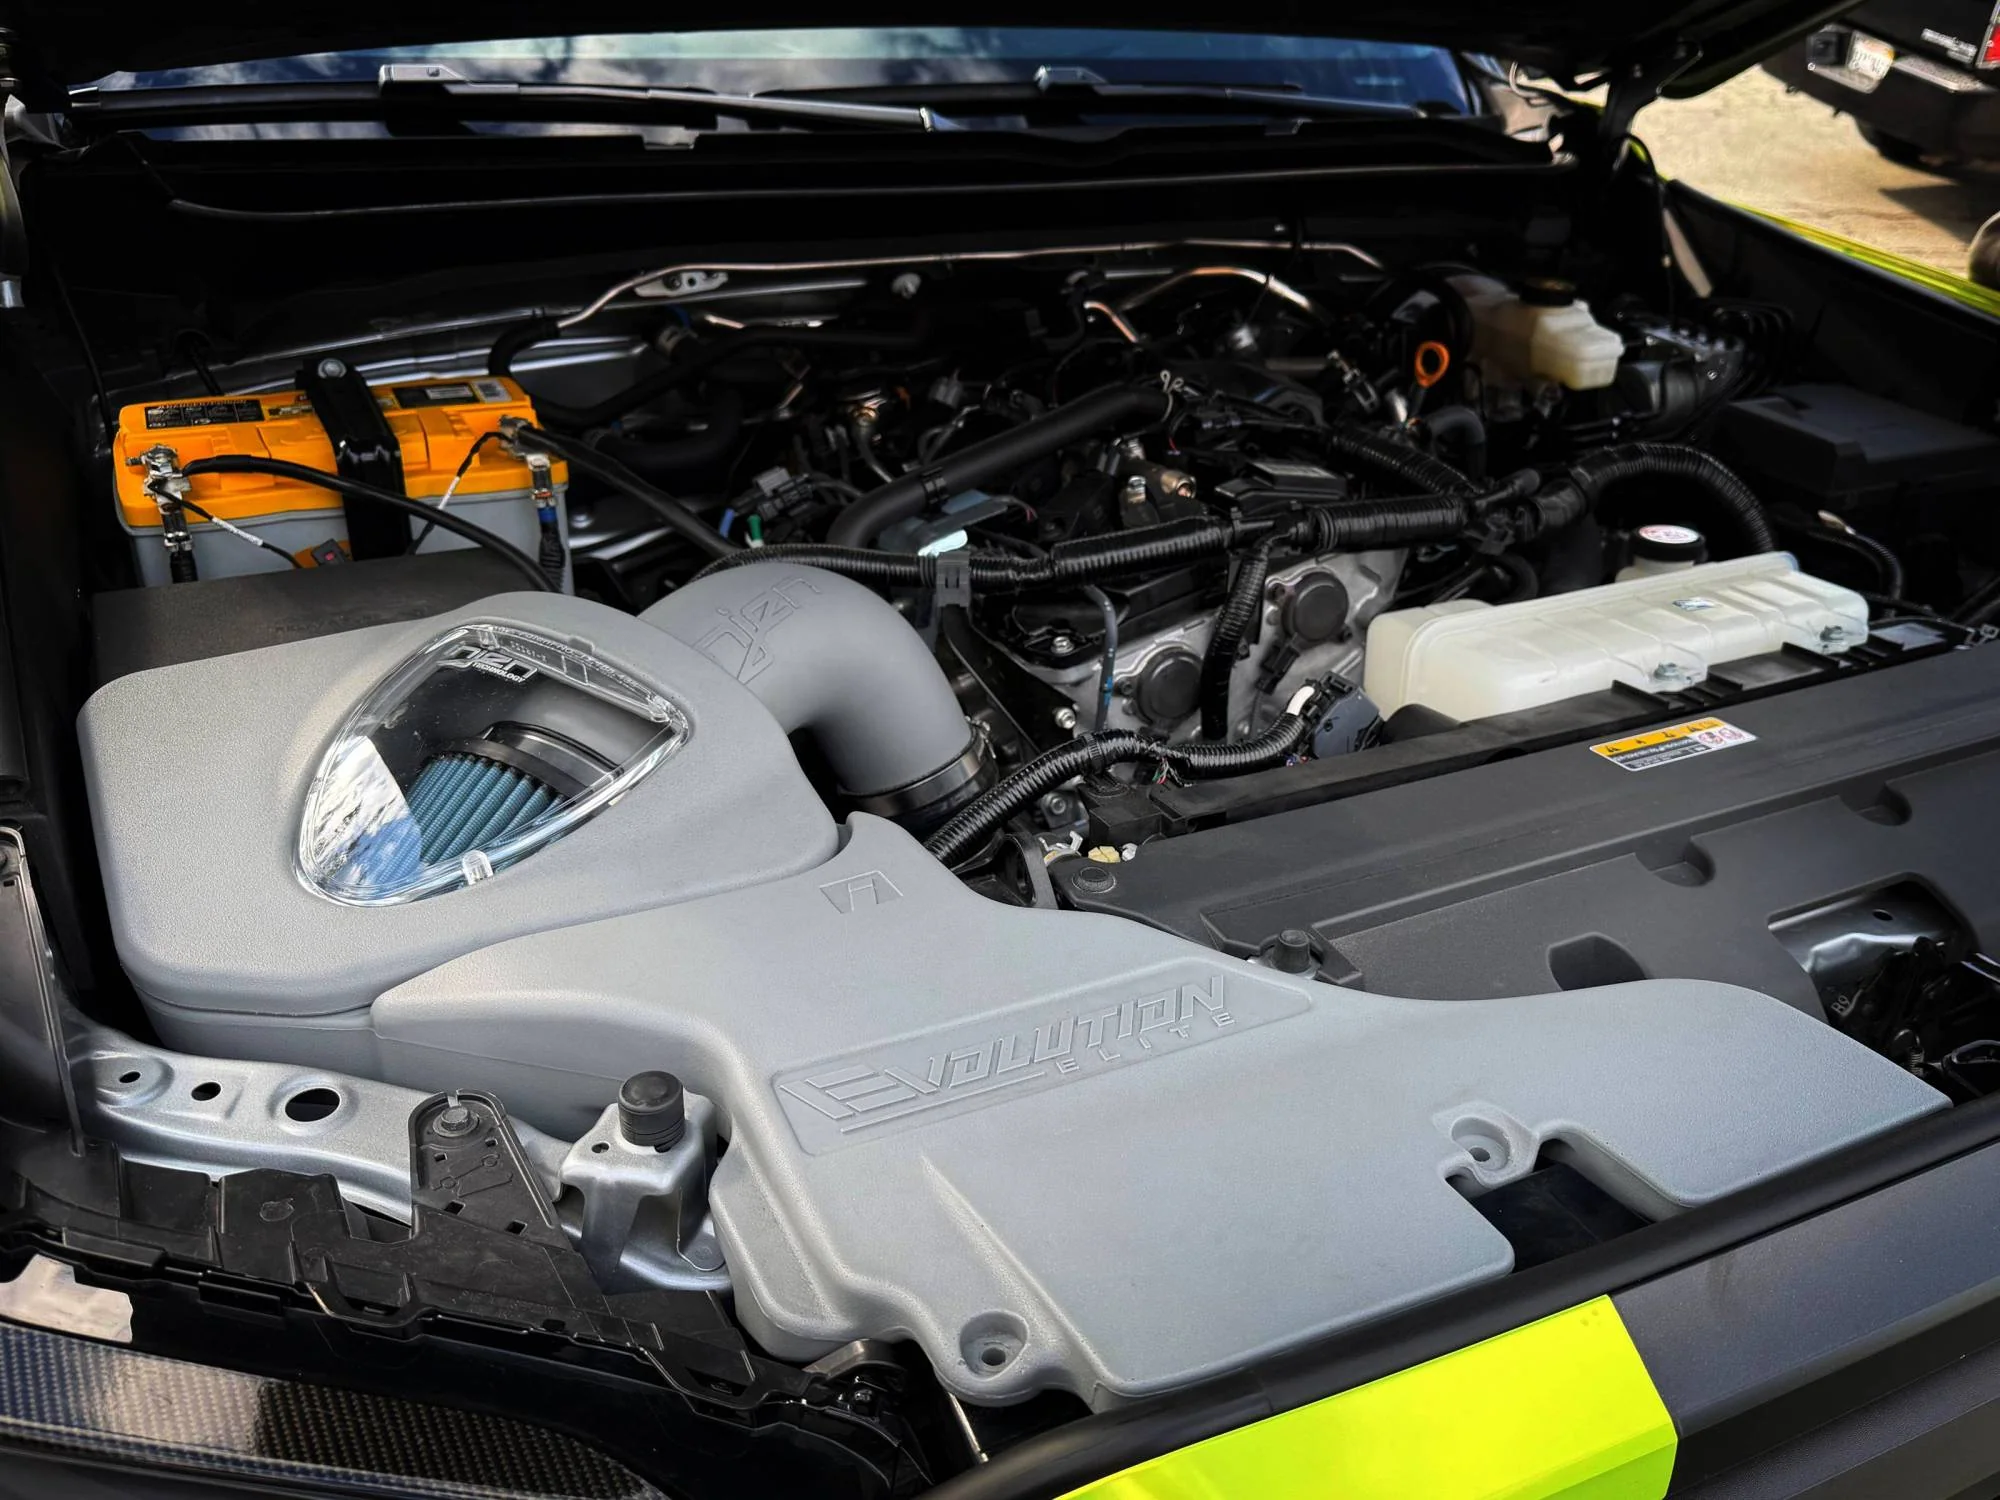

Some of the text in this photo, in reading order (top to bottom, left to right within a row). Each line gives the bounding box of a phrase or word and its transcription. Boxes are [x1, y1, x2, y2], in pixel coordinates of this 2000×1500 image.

[472, 661, 526, 683] TECHNOLOGY
[779, 974, 1227, 1121] EVOLUTION
[1055, 1010, 1236, 1075] ELITE
